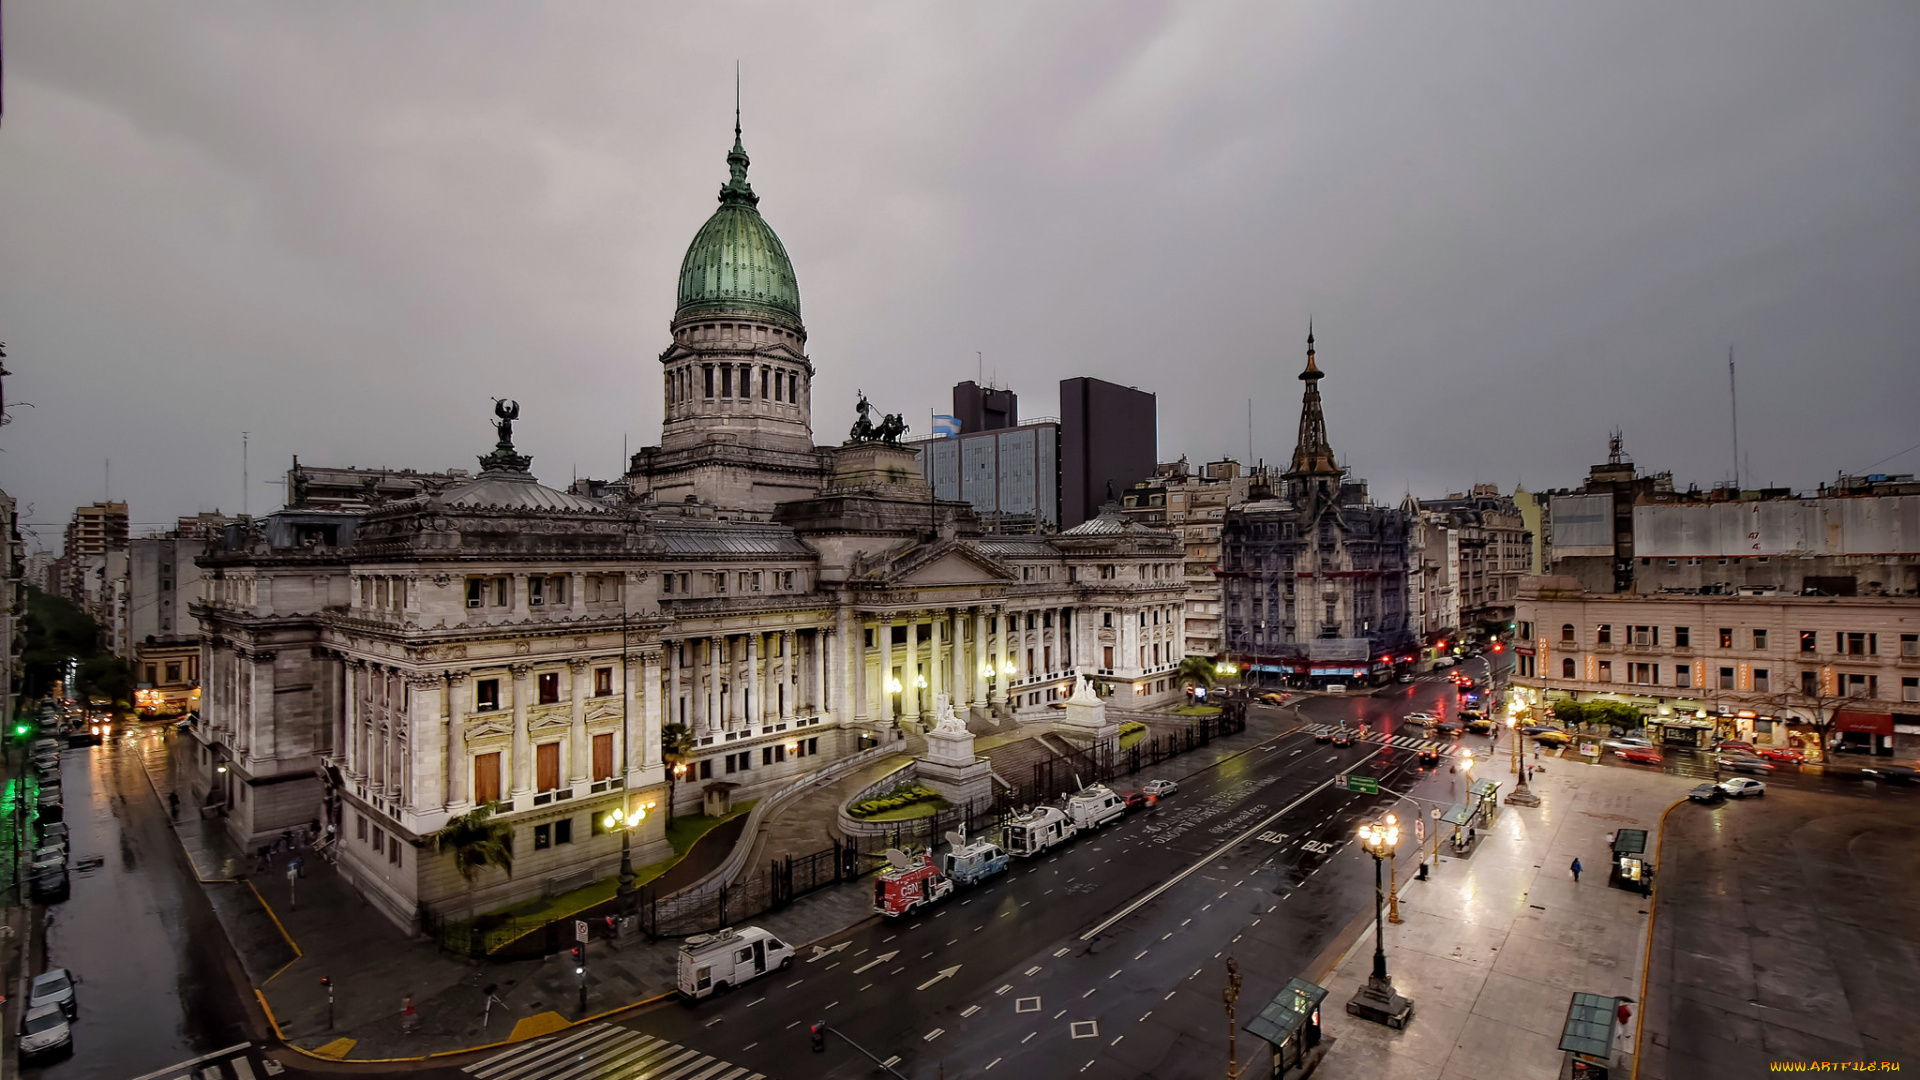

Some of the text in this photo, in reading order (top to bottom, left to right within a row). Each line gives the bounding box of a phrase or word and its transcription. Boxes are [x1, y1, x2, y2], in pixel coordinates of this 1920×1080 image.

[1740, 663, 1748, 689] HOSTEL
[1256, 830, 1289, 844] BUS
[1300, 840, 1334, 854] BUS
[900, 882, 919, 897] C5N
